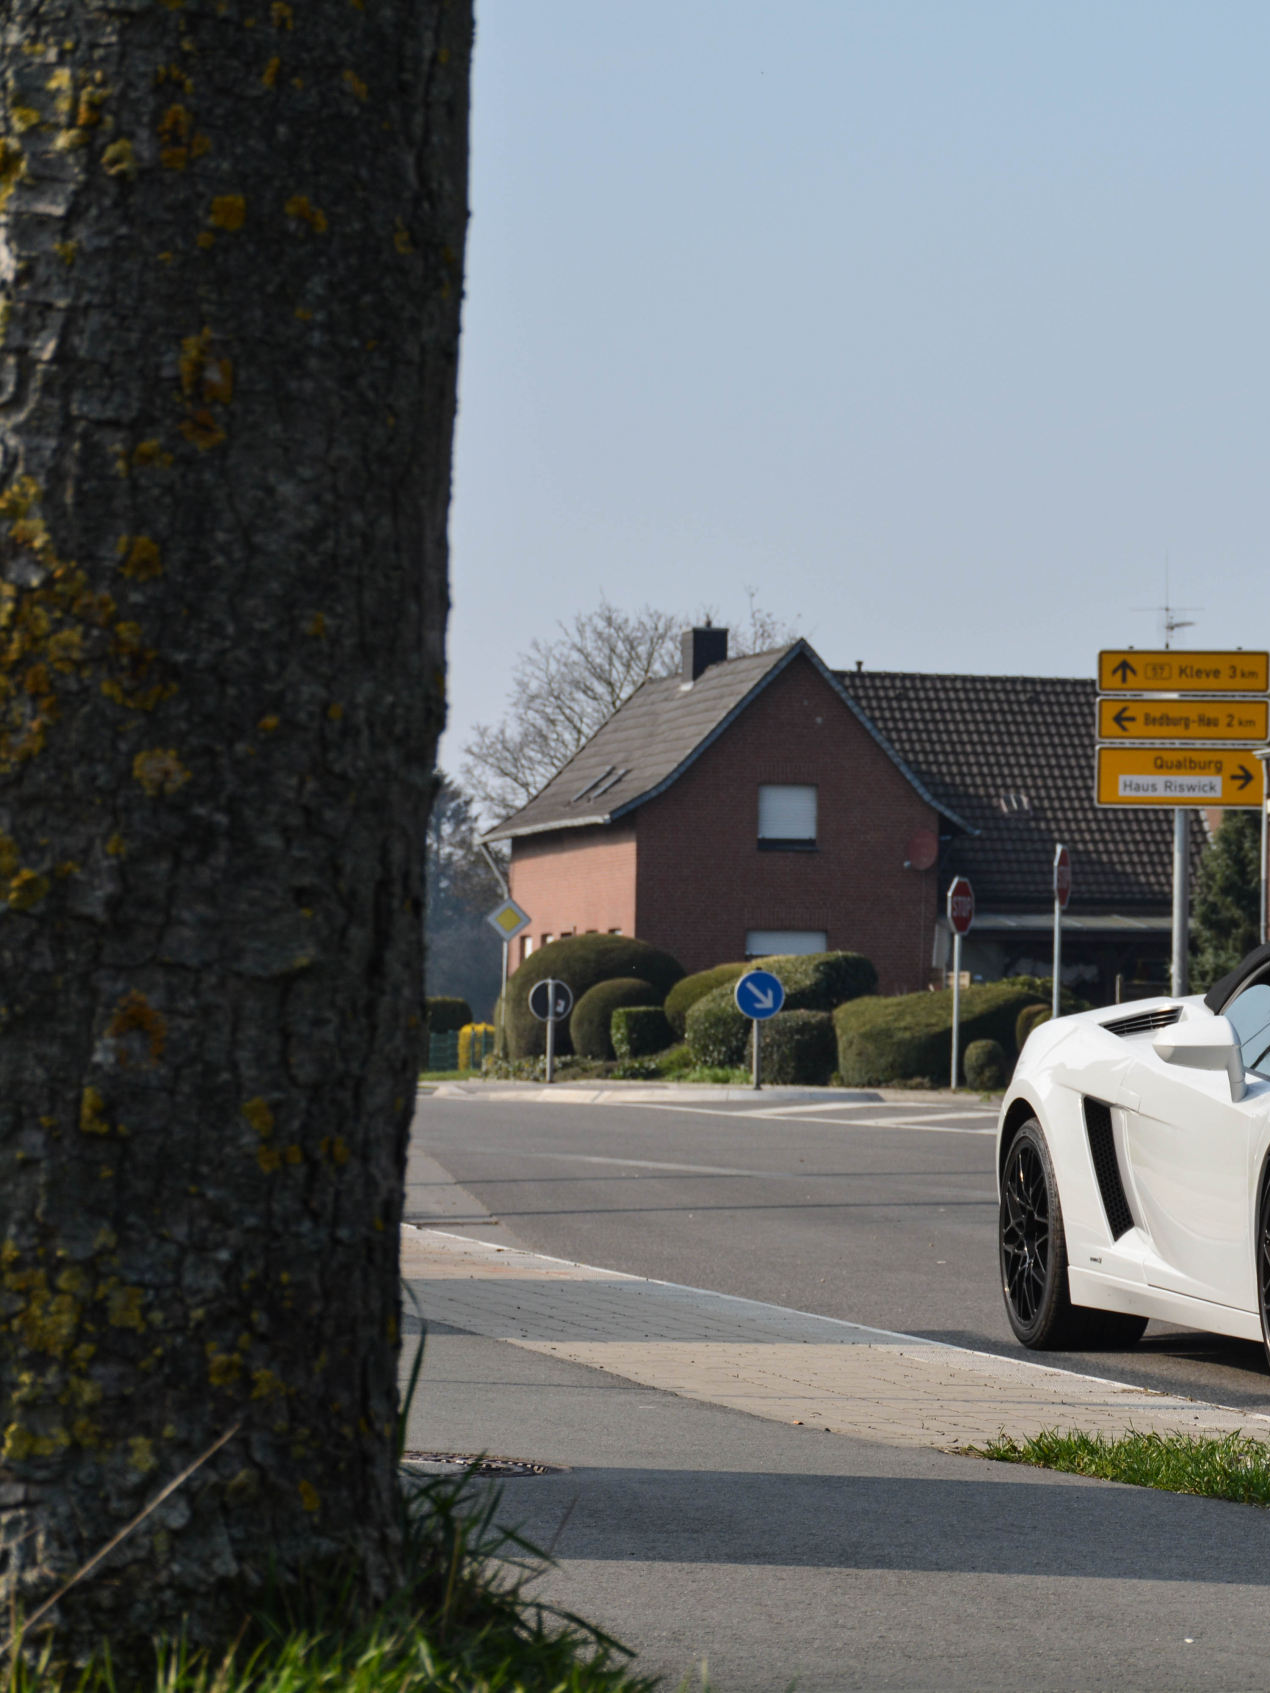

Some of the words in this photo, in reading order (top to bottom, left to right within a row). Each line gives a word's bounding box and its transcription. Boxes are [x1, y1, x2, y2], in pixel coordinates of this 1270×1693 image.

[1178, 665, 1221, 679] Kleve
[1228, 666, 1237, 679] 3
[1240, 668, 1258, 679] km
[1143, 713, 1219, 730] Bedburg-Hau
[1226, 714, 1235, 728] 2
[1237, 716, 1256, 728] km
[1153, 756, 1223, 773] Qualburg
[1123, 780, 1157, 792] Haus
[1164, 780, 1217, 793] Riswick
[952, 896, 972, 918] STOP
